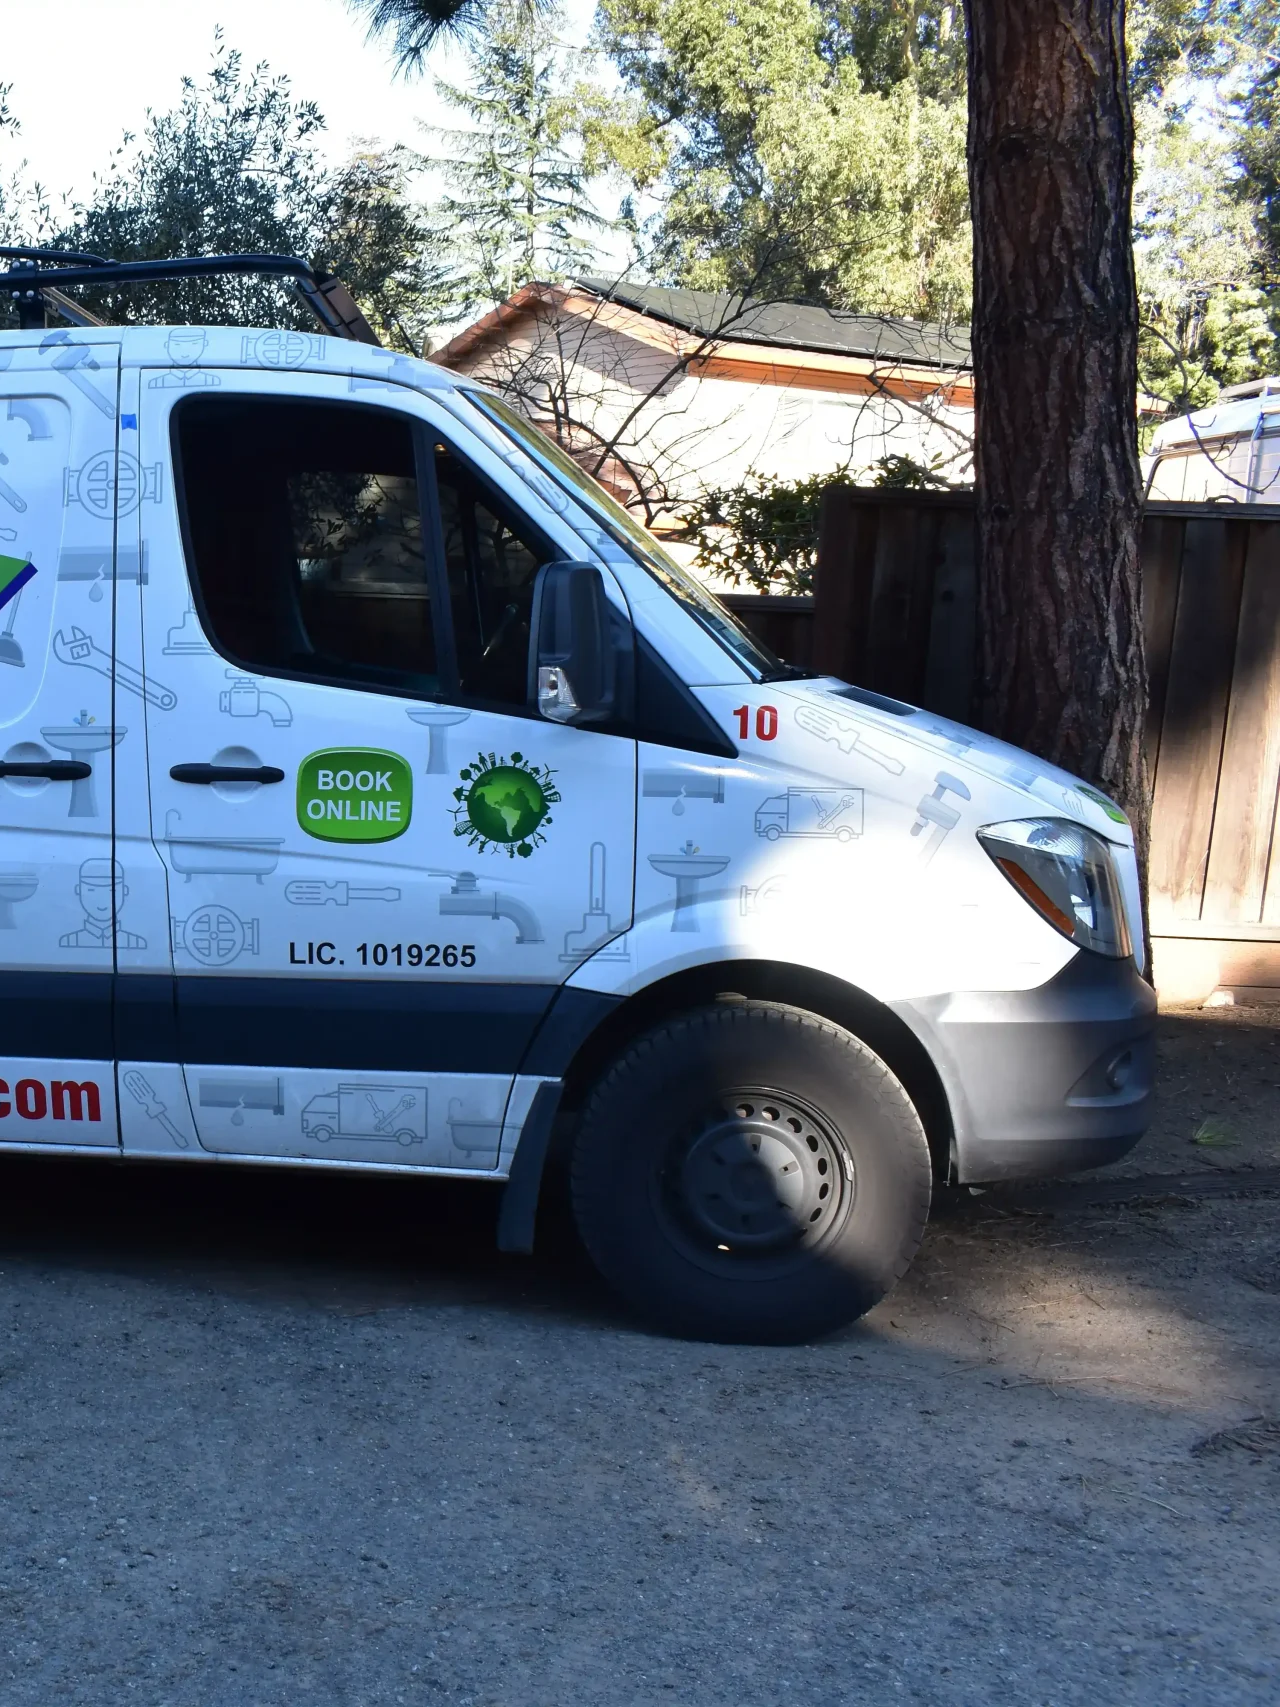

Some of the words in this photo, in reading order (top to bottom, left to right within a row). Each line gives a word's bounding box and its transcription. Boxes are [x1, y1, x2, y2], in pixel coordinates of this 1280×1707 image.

[732, 705, 779, 742] 10
[317, 770, 393, 792] BOOK
[306, 799, 402, 822] ONLINE
[289, 942, 345, 966] LIC.
[356, 943, 477, 968] 1019265
